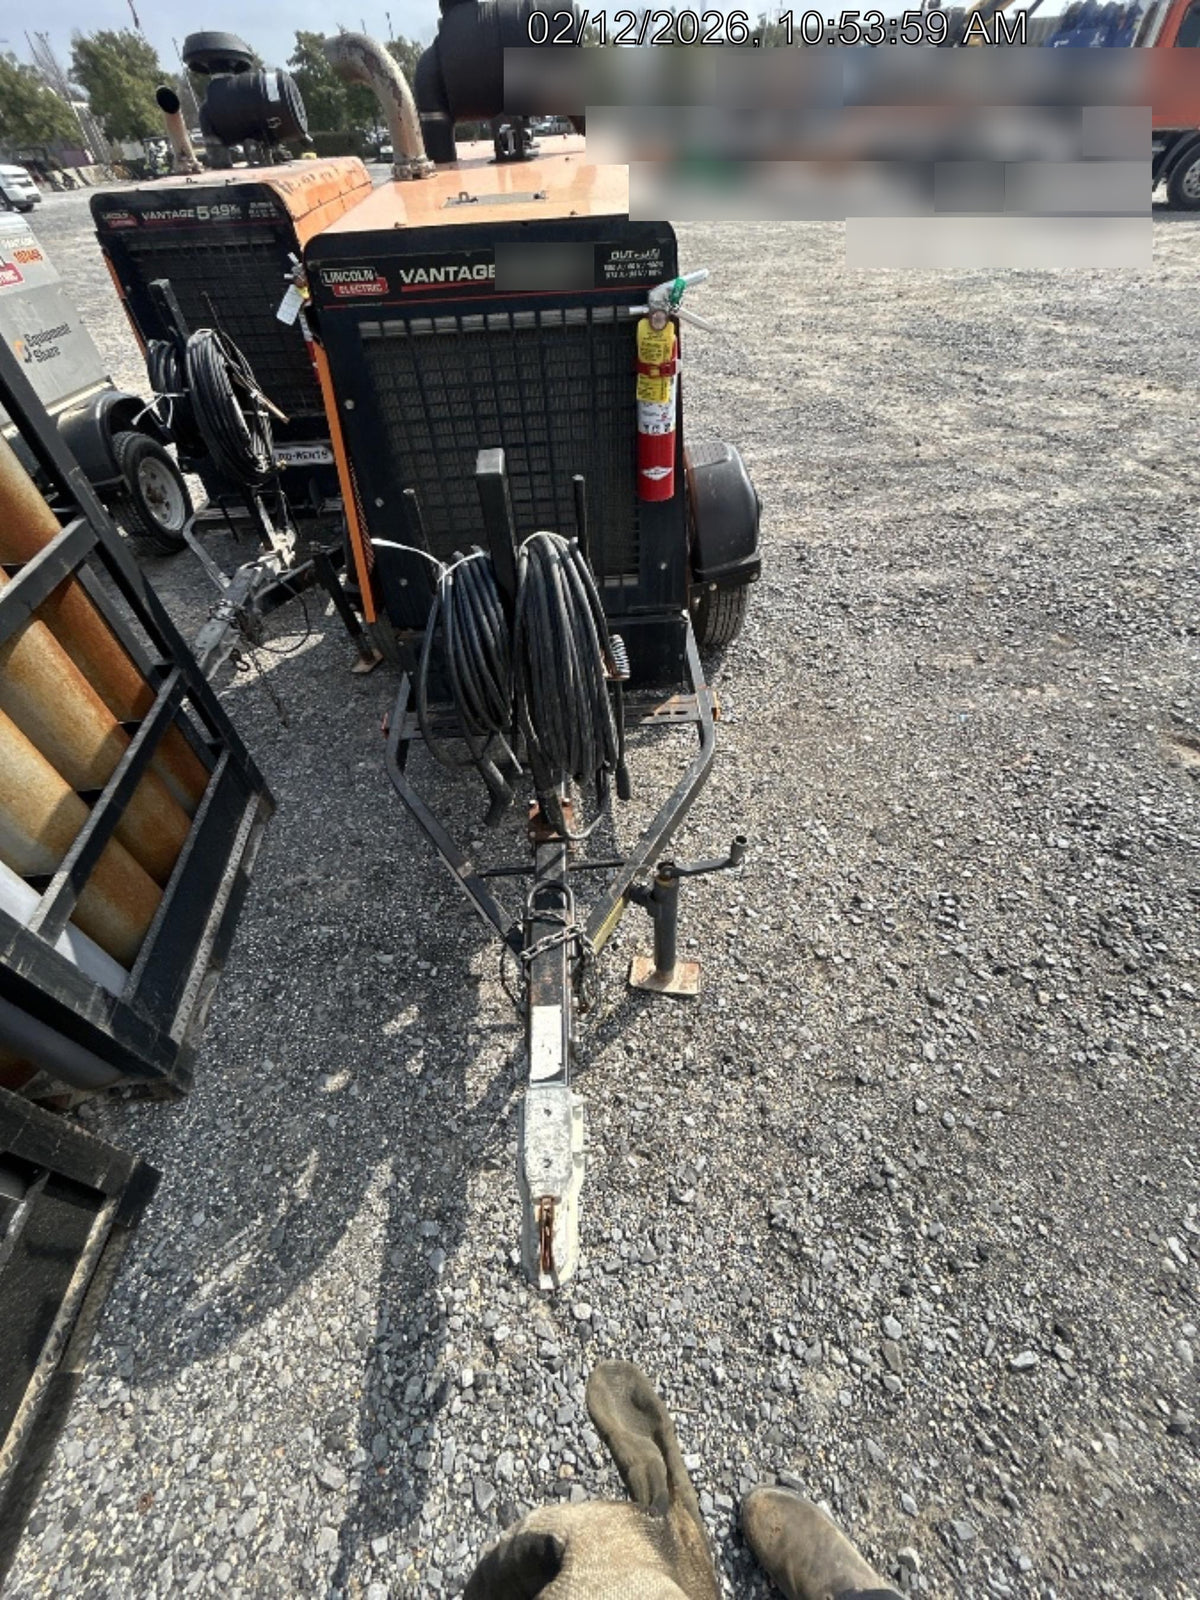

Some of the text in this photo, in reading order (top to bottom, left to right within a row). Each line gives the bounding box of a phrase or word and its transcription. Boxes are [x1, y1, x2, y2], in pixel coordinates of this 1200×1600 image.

[141, 209, 195, 221] VANTAGE
[323, 267, 374, 284] LINCOLN
[339, 283, 383, 294] ELECTRIC
